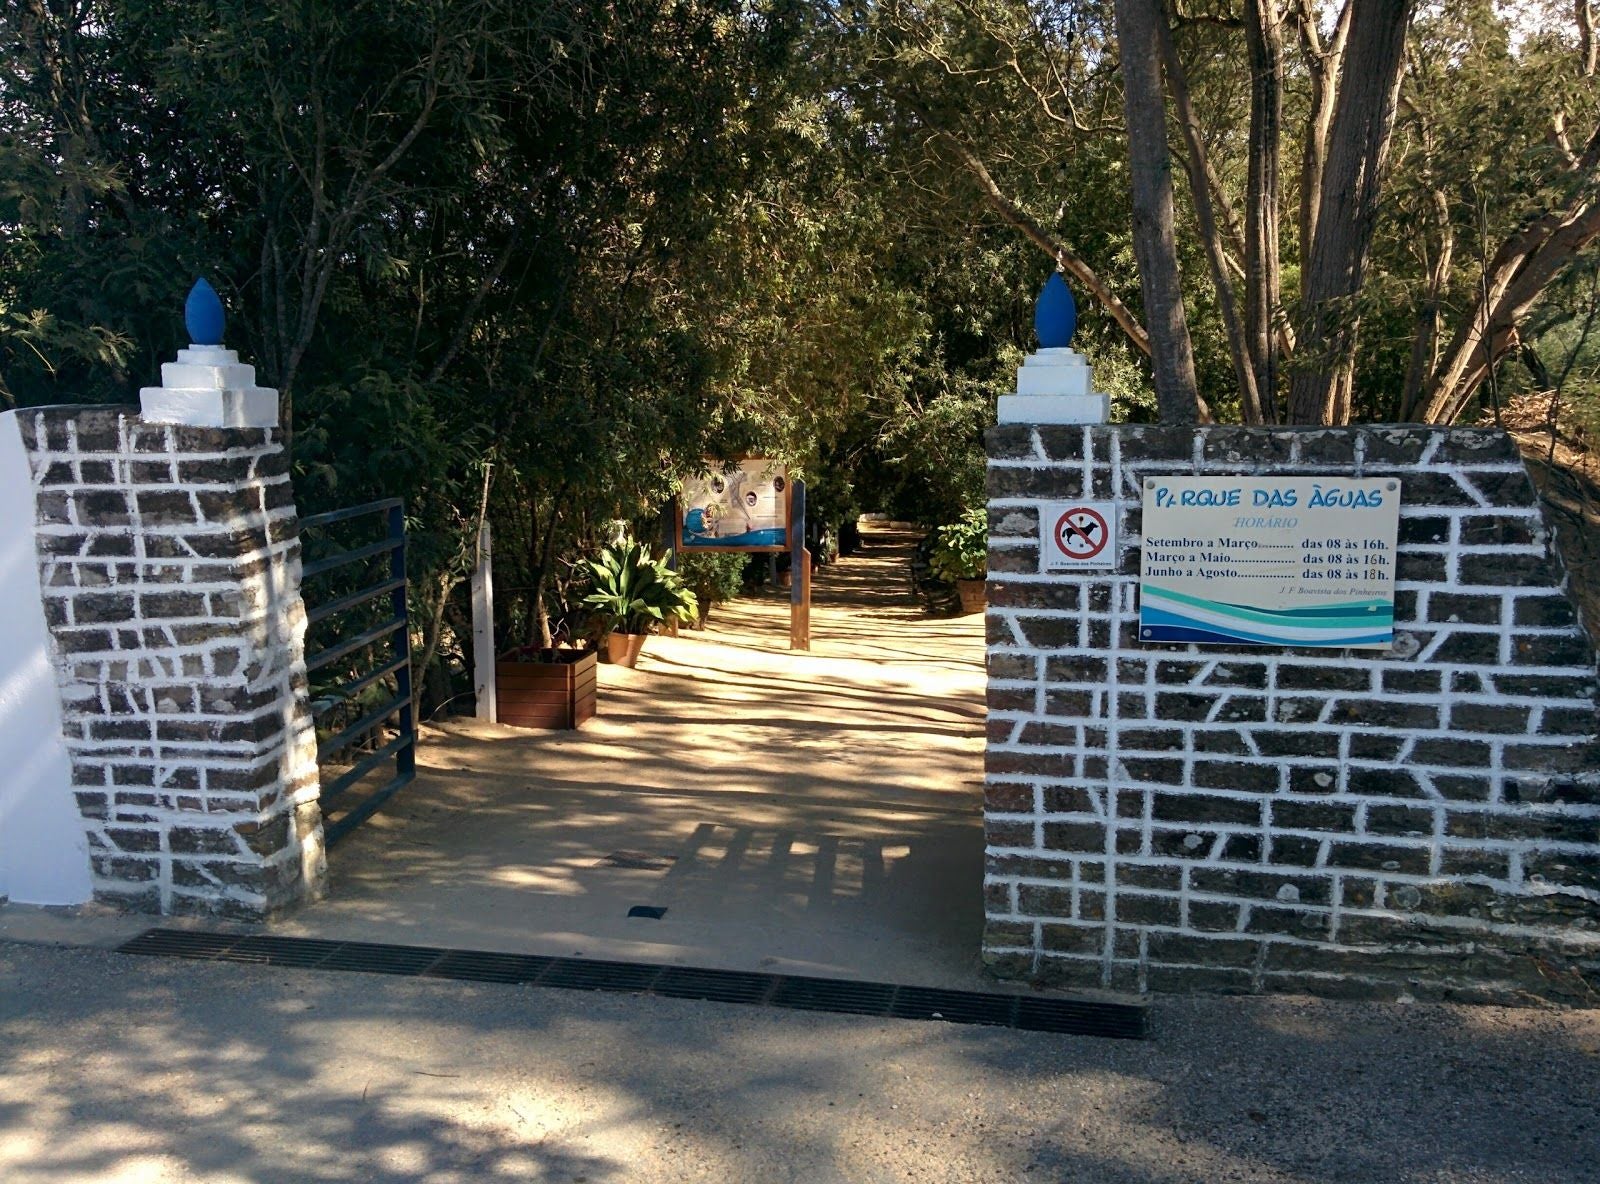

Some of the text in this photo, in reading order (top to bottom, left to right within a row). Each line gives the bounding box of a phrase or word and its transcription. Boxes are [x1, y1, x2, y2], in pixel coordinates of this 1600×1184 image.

[1252, 489, 1298, 508] DAS
[1234, 514, 1298, 529] HORÁRIO
[1146, 537, 1203, 548] Setembro
[1207, 540, 1214, 548] a
[1301, 538, 1322, 549] das
[1326, 538, 1341, 549] 08
[1345, 538, 1358, 549] às
[1363, 539, 1389, 550] 16h.
[1146, 551, 1185, 564] Março
[1303, 553, 1324, 564] das
[1327, 554, 1342, 564] 08
[1346, 554, 1359, 565] às
[1364, 554, 1390, 565] 16h.
[1145, 566, 1182, 577] Junho
[1186, 569, 1193, 577] a
[1302, 568, 1323, 579] das
[1327, 569, 1342, 579] 08
[1345, 569, 1358, 579] às
[1363, 569, 1389, 580] 18h.
[1297, 586, 1331, 595] Boavista
[1333, 587, 1347, 595] dos
